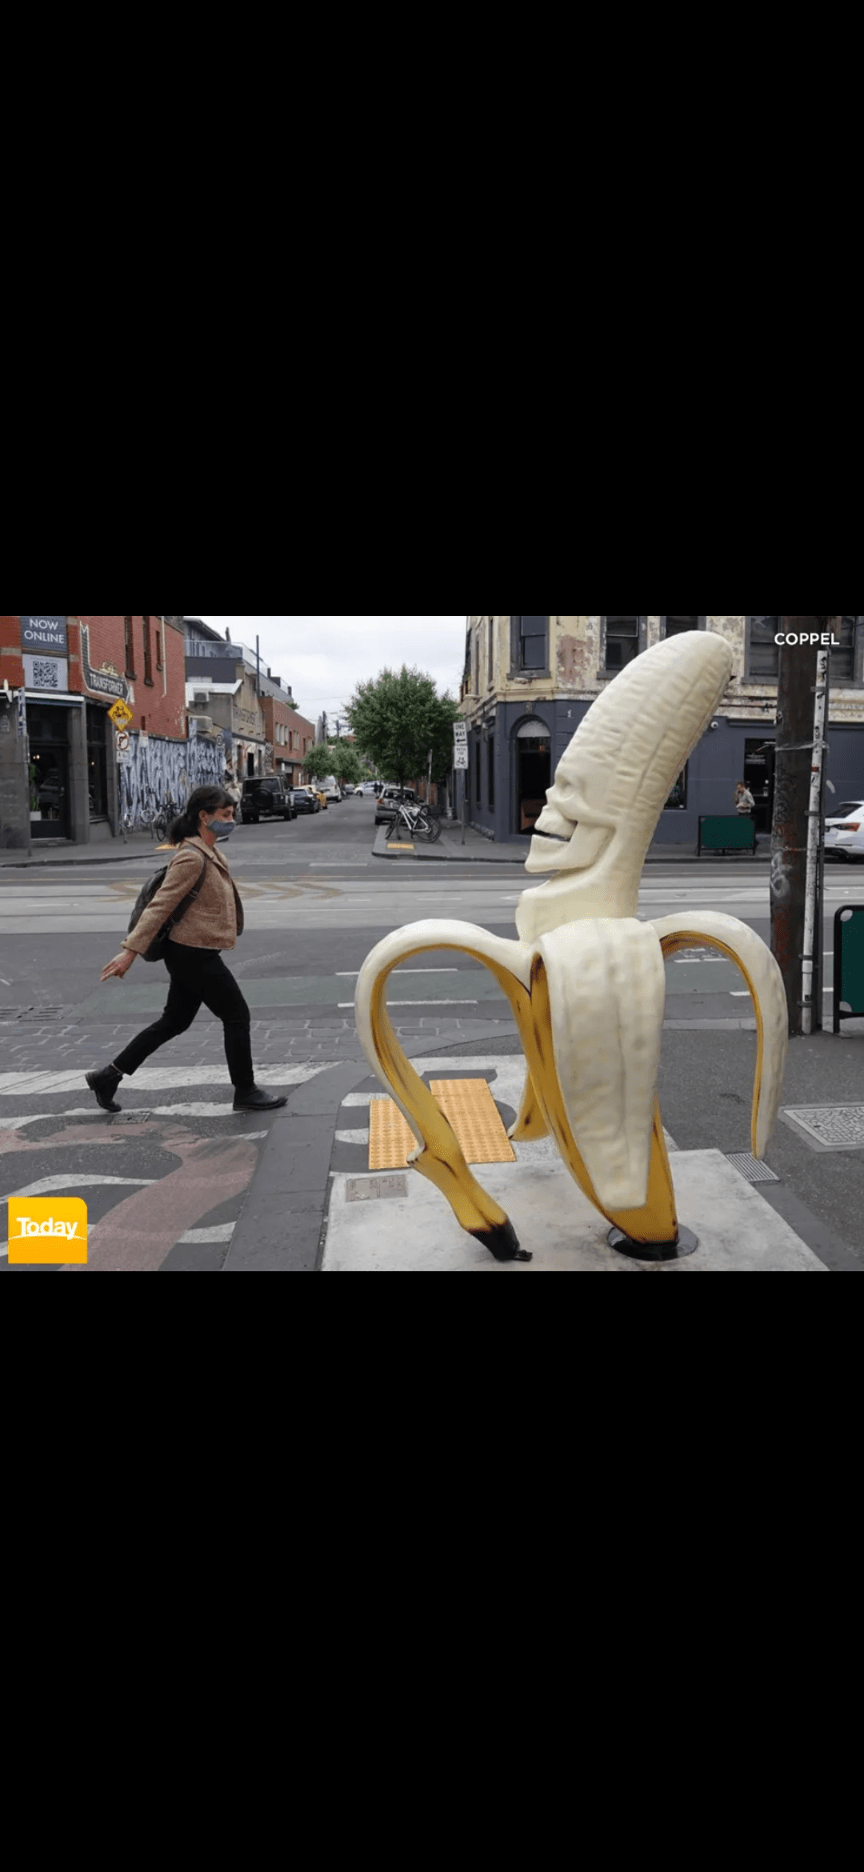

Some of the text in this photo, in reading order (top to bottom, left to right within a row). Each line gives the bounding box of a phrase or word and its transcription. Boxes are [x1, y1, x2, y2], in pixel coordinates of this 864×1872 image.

[29, 618, 59, 630] NOW
[24, 630, 65, 644] ONLINE
[89, 672, 125, 696] TRANSFORMER
